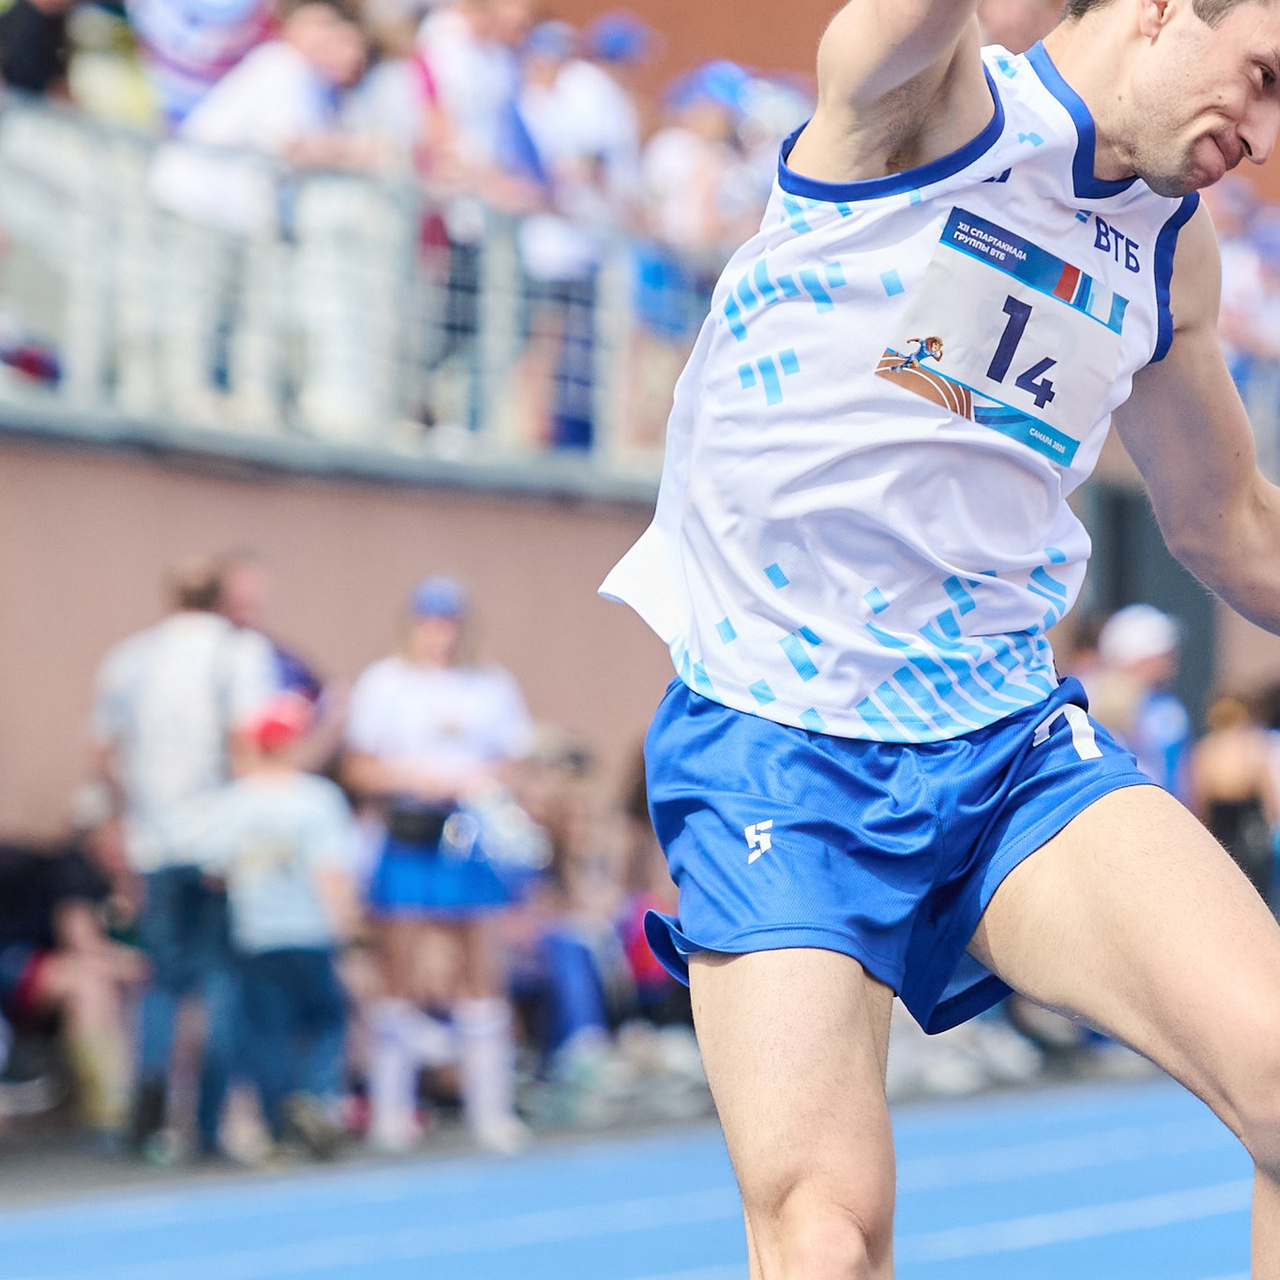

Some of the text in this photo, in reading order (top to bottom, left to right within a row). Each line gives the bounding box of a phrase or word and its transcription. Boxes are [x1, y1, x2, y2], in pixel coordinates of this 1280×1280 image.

[953, 230, 1007, 261] ГРУППЫ ВТБ
[970, 227, 1028, 261] СПАРТАКИАДА
[1093, 215, 1141, 273] ВТБ
